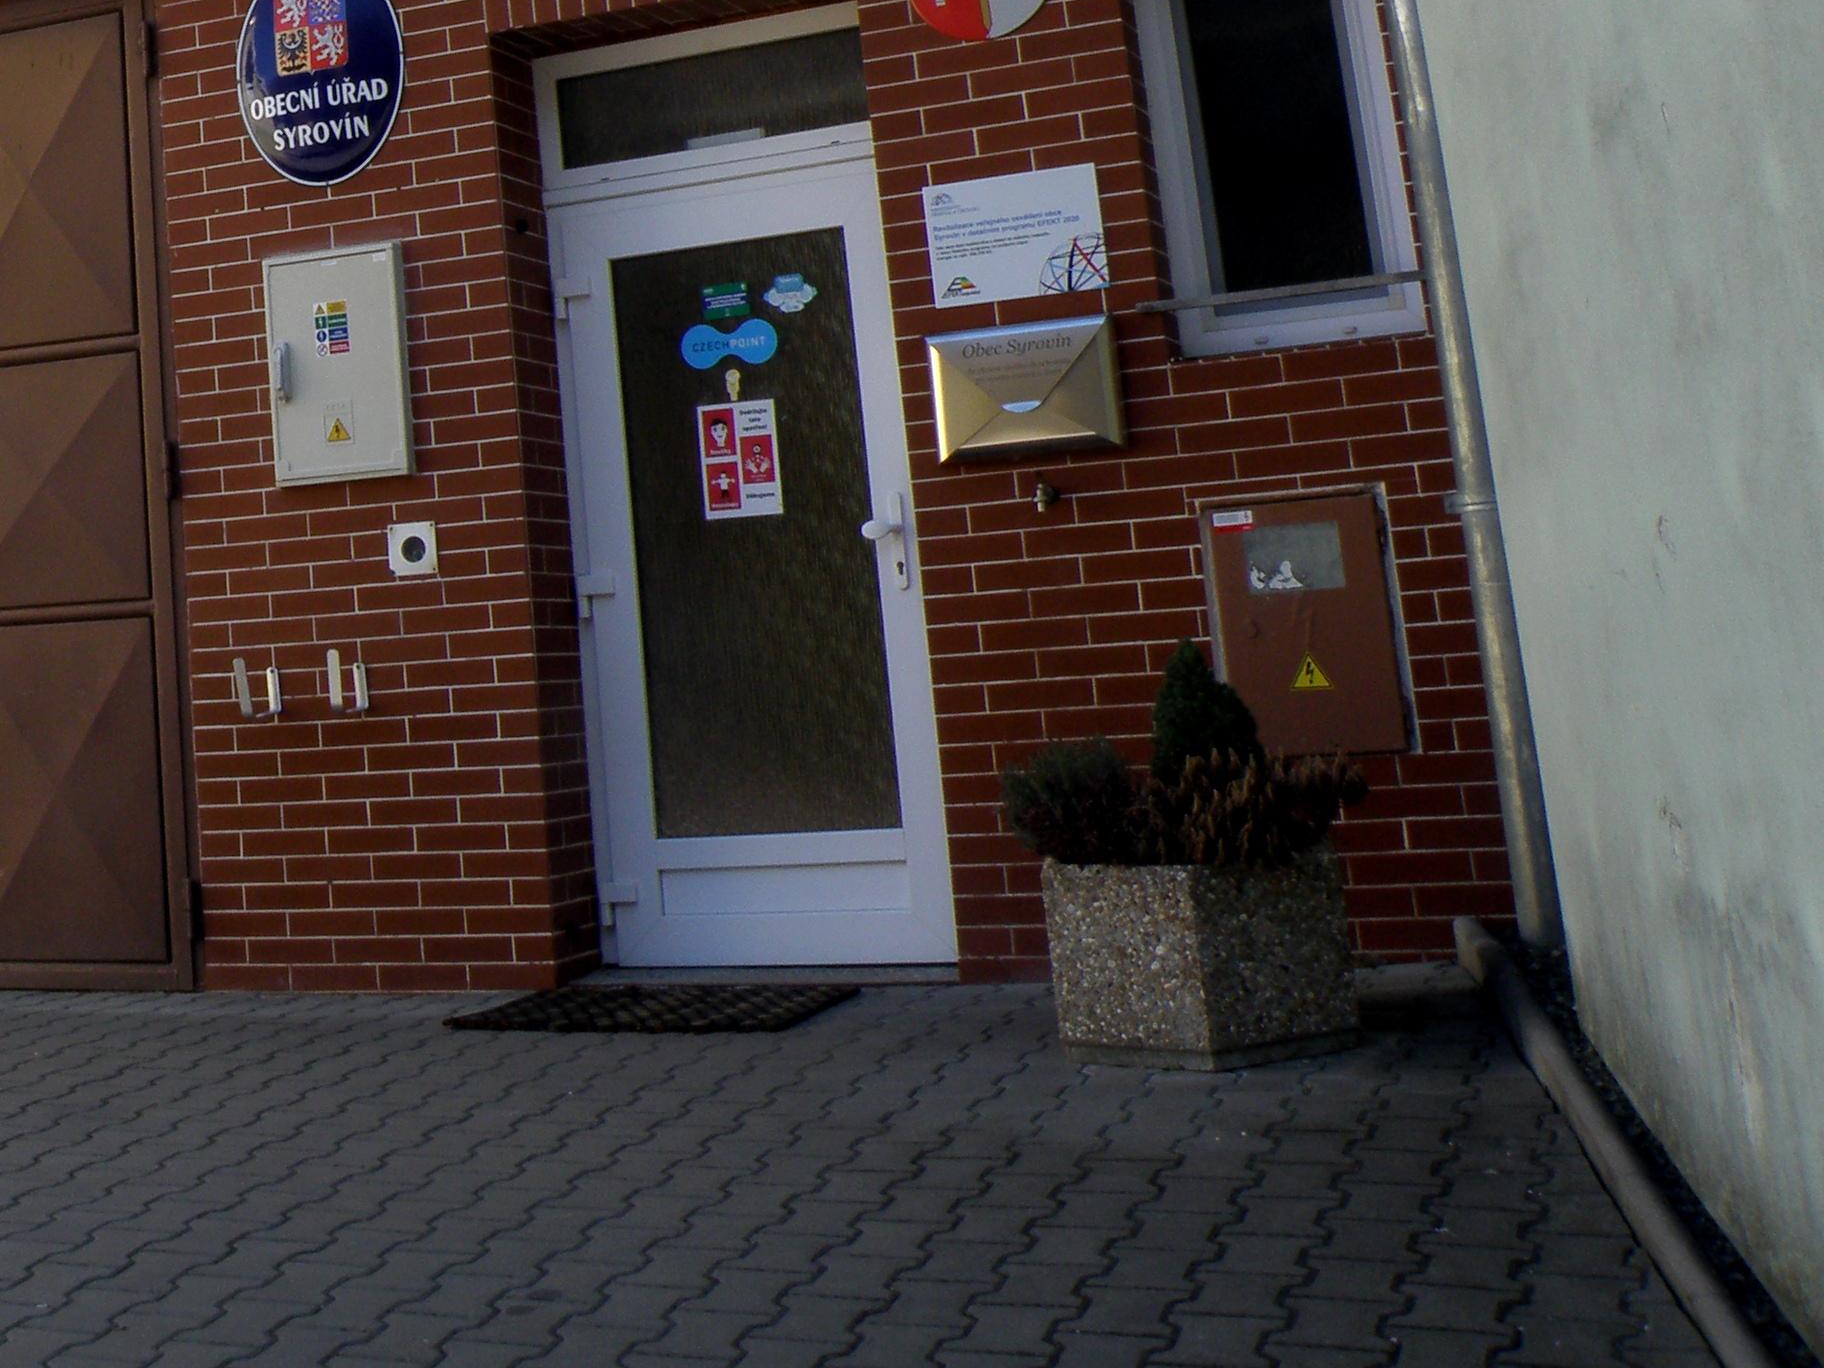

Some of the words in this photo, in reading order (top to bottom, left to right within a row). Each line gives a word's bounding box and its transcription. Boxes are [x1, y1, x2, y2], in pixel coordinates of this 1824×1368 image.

[250, 81, 320, 120] OBECNÍ
[327, 77, 388, 106] ÚŘAD
[273, 112, 370, 151] SYROVÍN
[962, 342, 1003, 359] Obec
